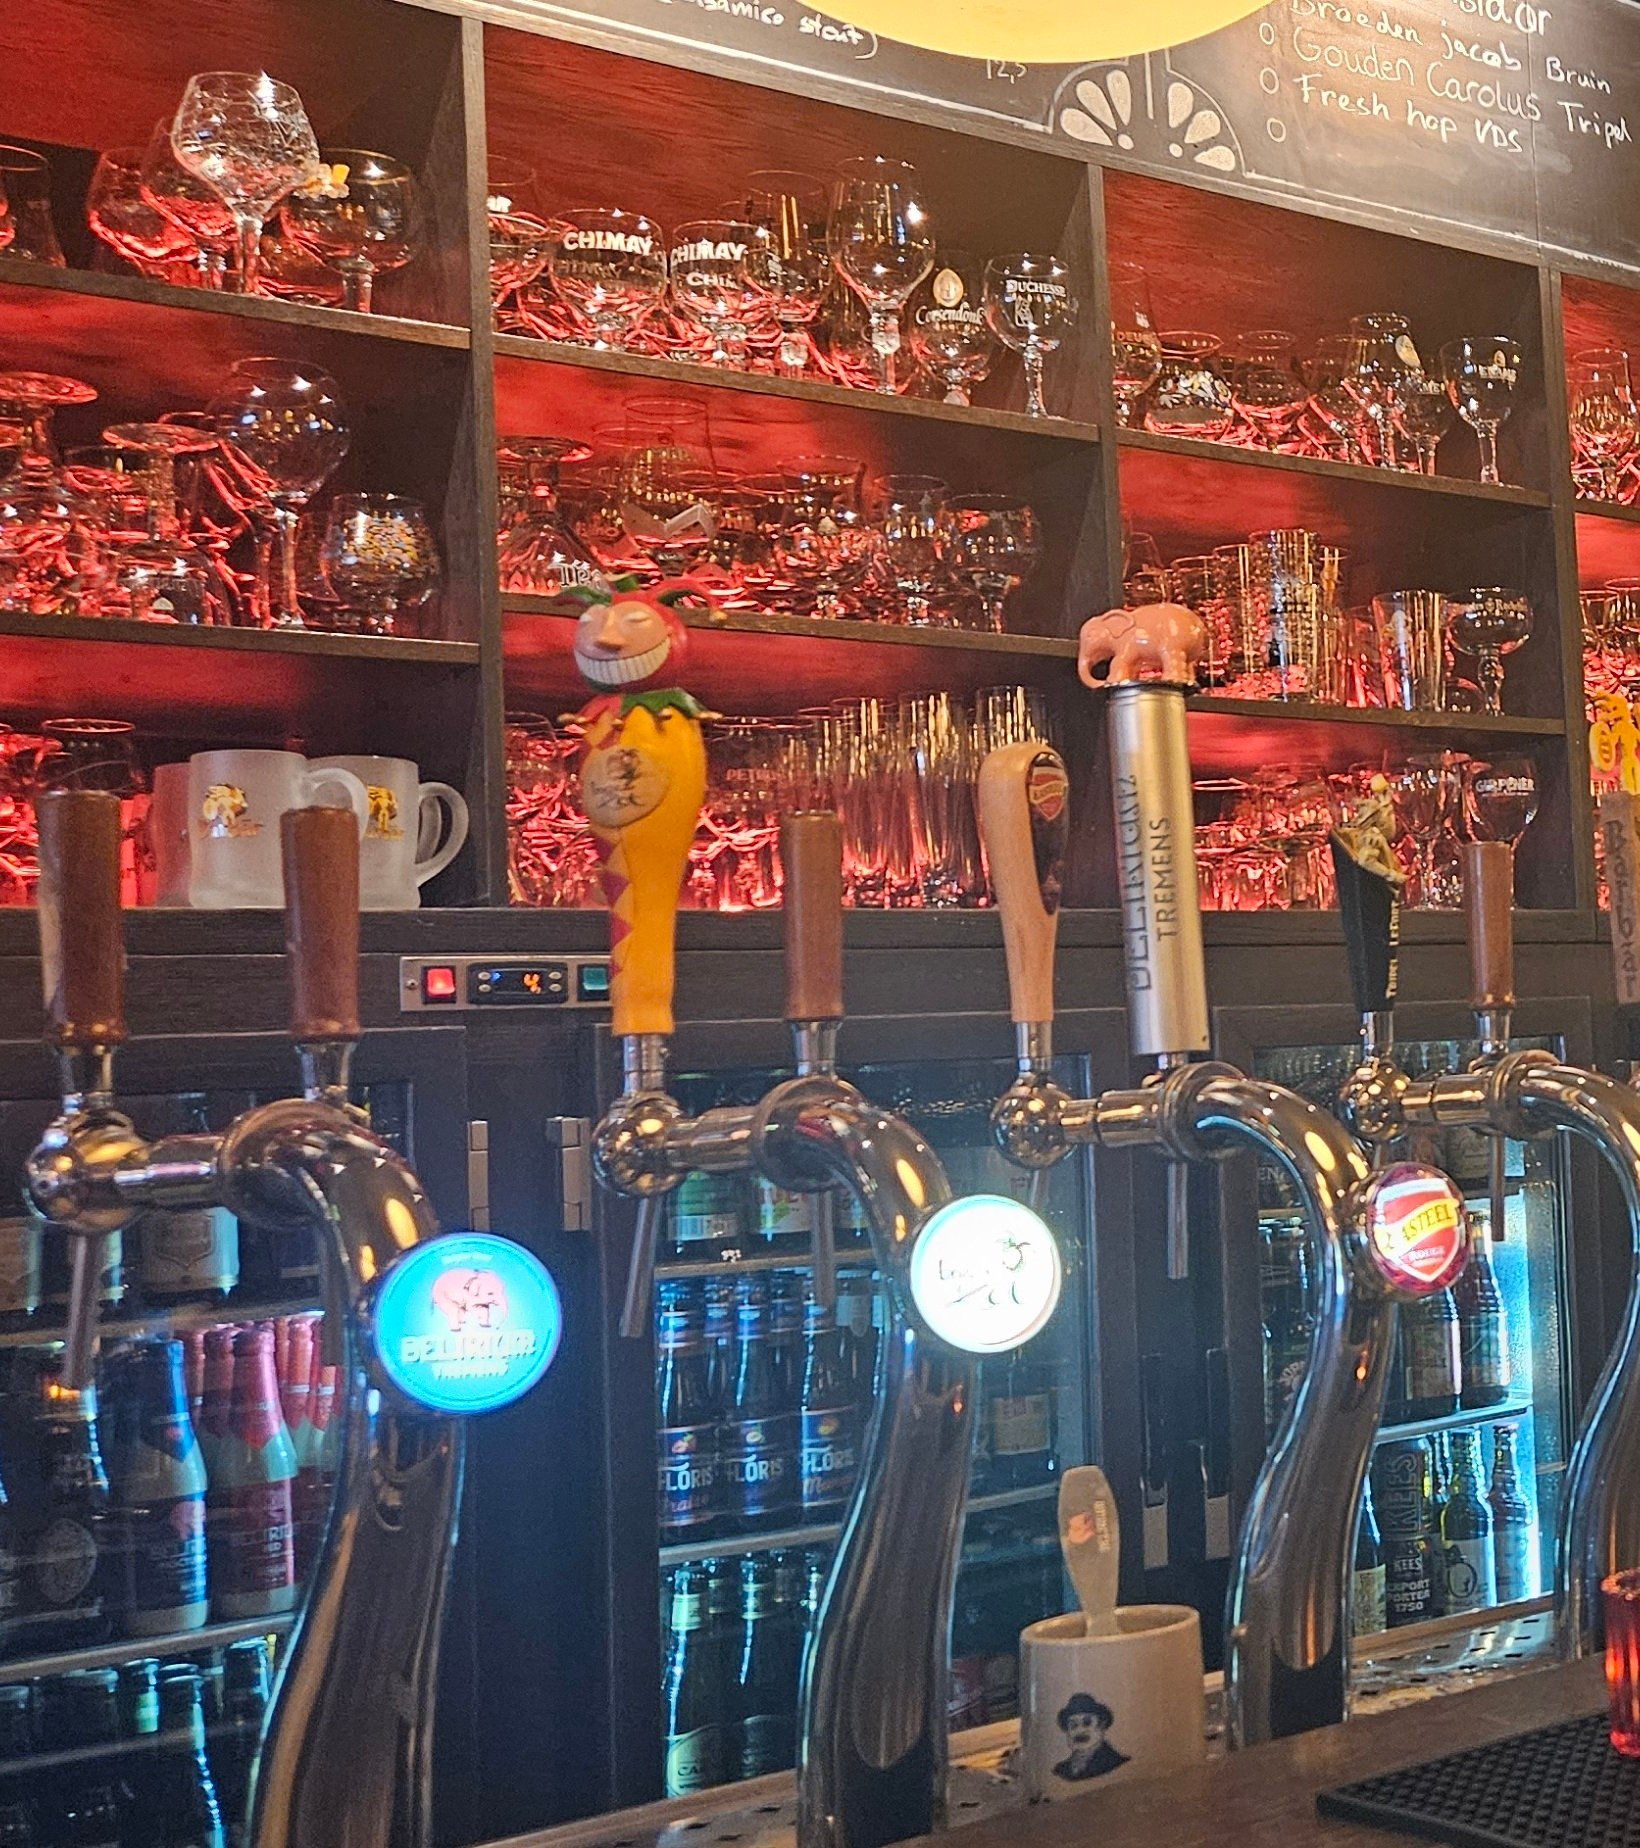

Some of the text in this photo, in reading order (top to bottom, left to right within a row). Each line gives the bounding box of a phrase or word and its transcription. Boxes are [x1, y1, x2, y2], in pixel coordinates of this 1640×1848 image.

[1293, 26, 1415, 86] Gouden
[1426, 61, 1542, 122] Carolus
[1546, 56, 1611, 94] Bruin
[1293, 73, 1389, 120] Fresh
[1407, 99, 1457, 143] hop
[563, 231, 653, 256] CHIMAY
[671, 241, 746, 266] CHIMAY
[1148, 817, 1178, 942] TREMENS
